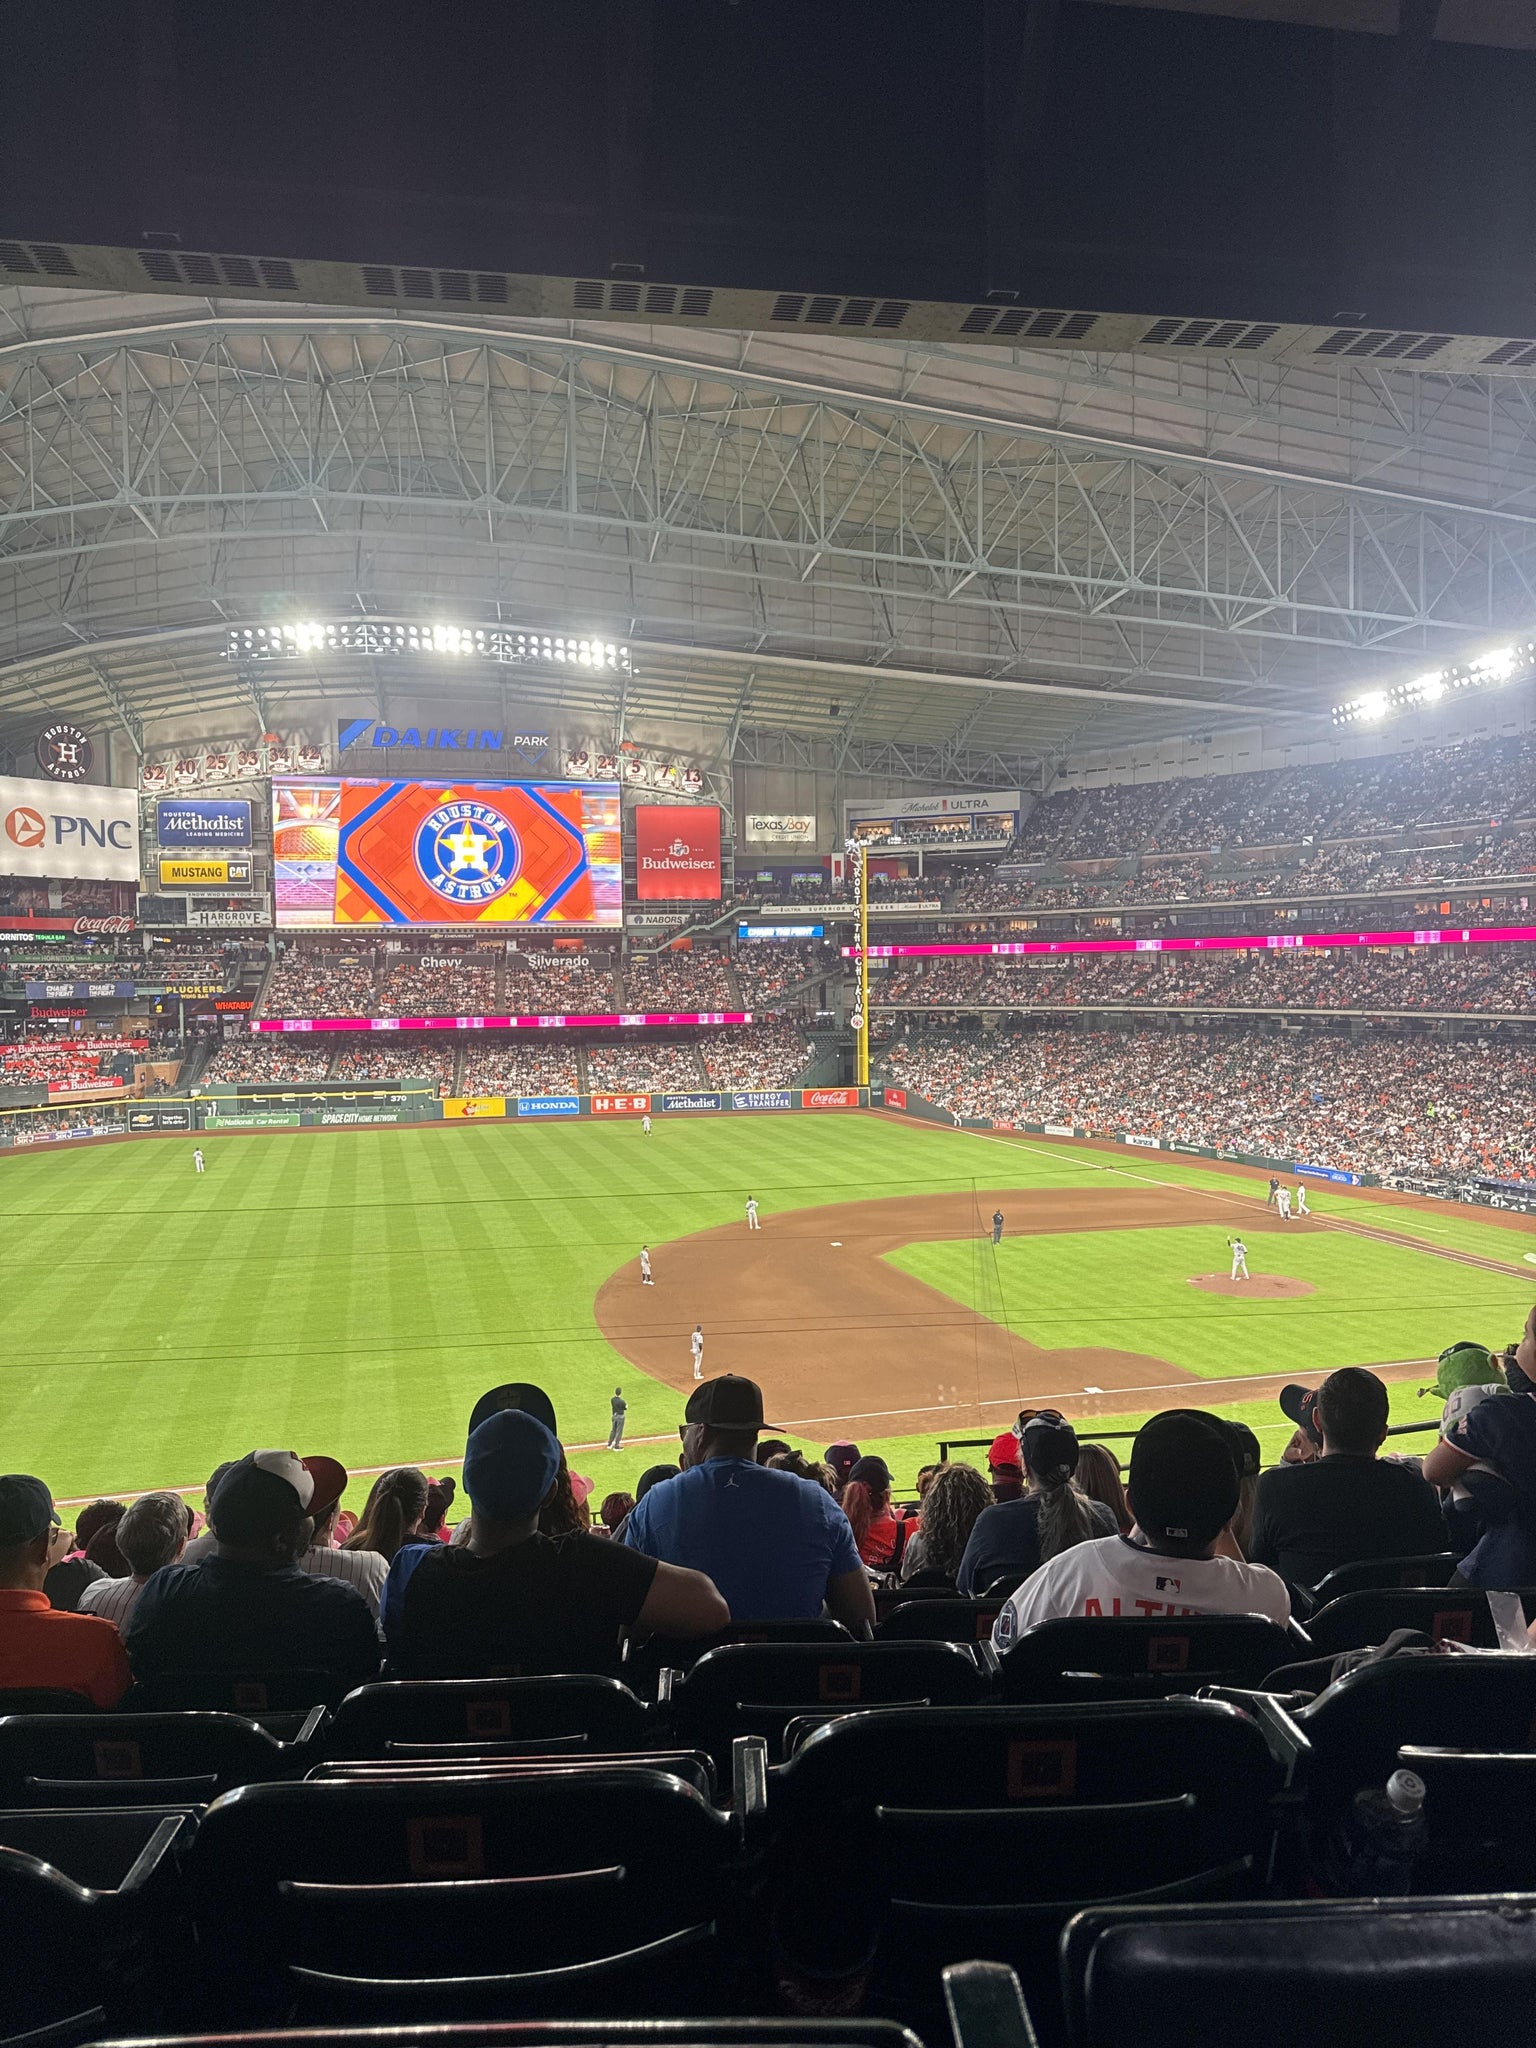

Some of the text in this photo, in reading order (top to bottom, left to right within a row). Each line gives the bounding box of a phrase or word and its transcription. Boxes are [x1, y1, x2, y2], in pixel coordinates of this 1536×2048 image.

[44, 726, 87, 743] HOUSTON
[372, 727, 549, 749] DAIKIN PARK
[206, 755, 227, 770] 25
[238, 751, 259, 765] 33
[598, 755, 617, 769] 24
[48, 763, 85, 778] ASTROS
[144, 766, 165, 780] 32
[175, 760, 196, 775] 40
[632, 760, 641, 773] 5
[661, 765, 670, 778] 7
[684, 769, 700, 782] 13
[951, 800, 989, 809] ULTRA
[164, 815, 244, 830] Methodist
[427, 805, 508, 832] HOUSTON
[50, 815, 132, 849] PNC
[751, 818, 811, 834] Texas Bay
[172, 867, 248, 878] MUSTANG CAT
[431, 873, 507, 899] ASTROS
[200, 912, 261, 925] HARGROVE
[646, 916, 683, 924] NABORS
[420, 955, 589, 968] Chevy Silverado
[30, 1007, 88, 1018] Budweiser
[18, 1044, 63, 1053] Budweiser
[87, 1040, 132, 1050] Budweiser
[71, 1080, 115, 1090] Budweiser
[667, 1097, 716, 1109] Methodist
[225, 1118, 254, 1126] National
[321, 1113, 345, 1124] SPACE
[344, 1113, 360, 1123] CITY
